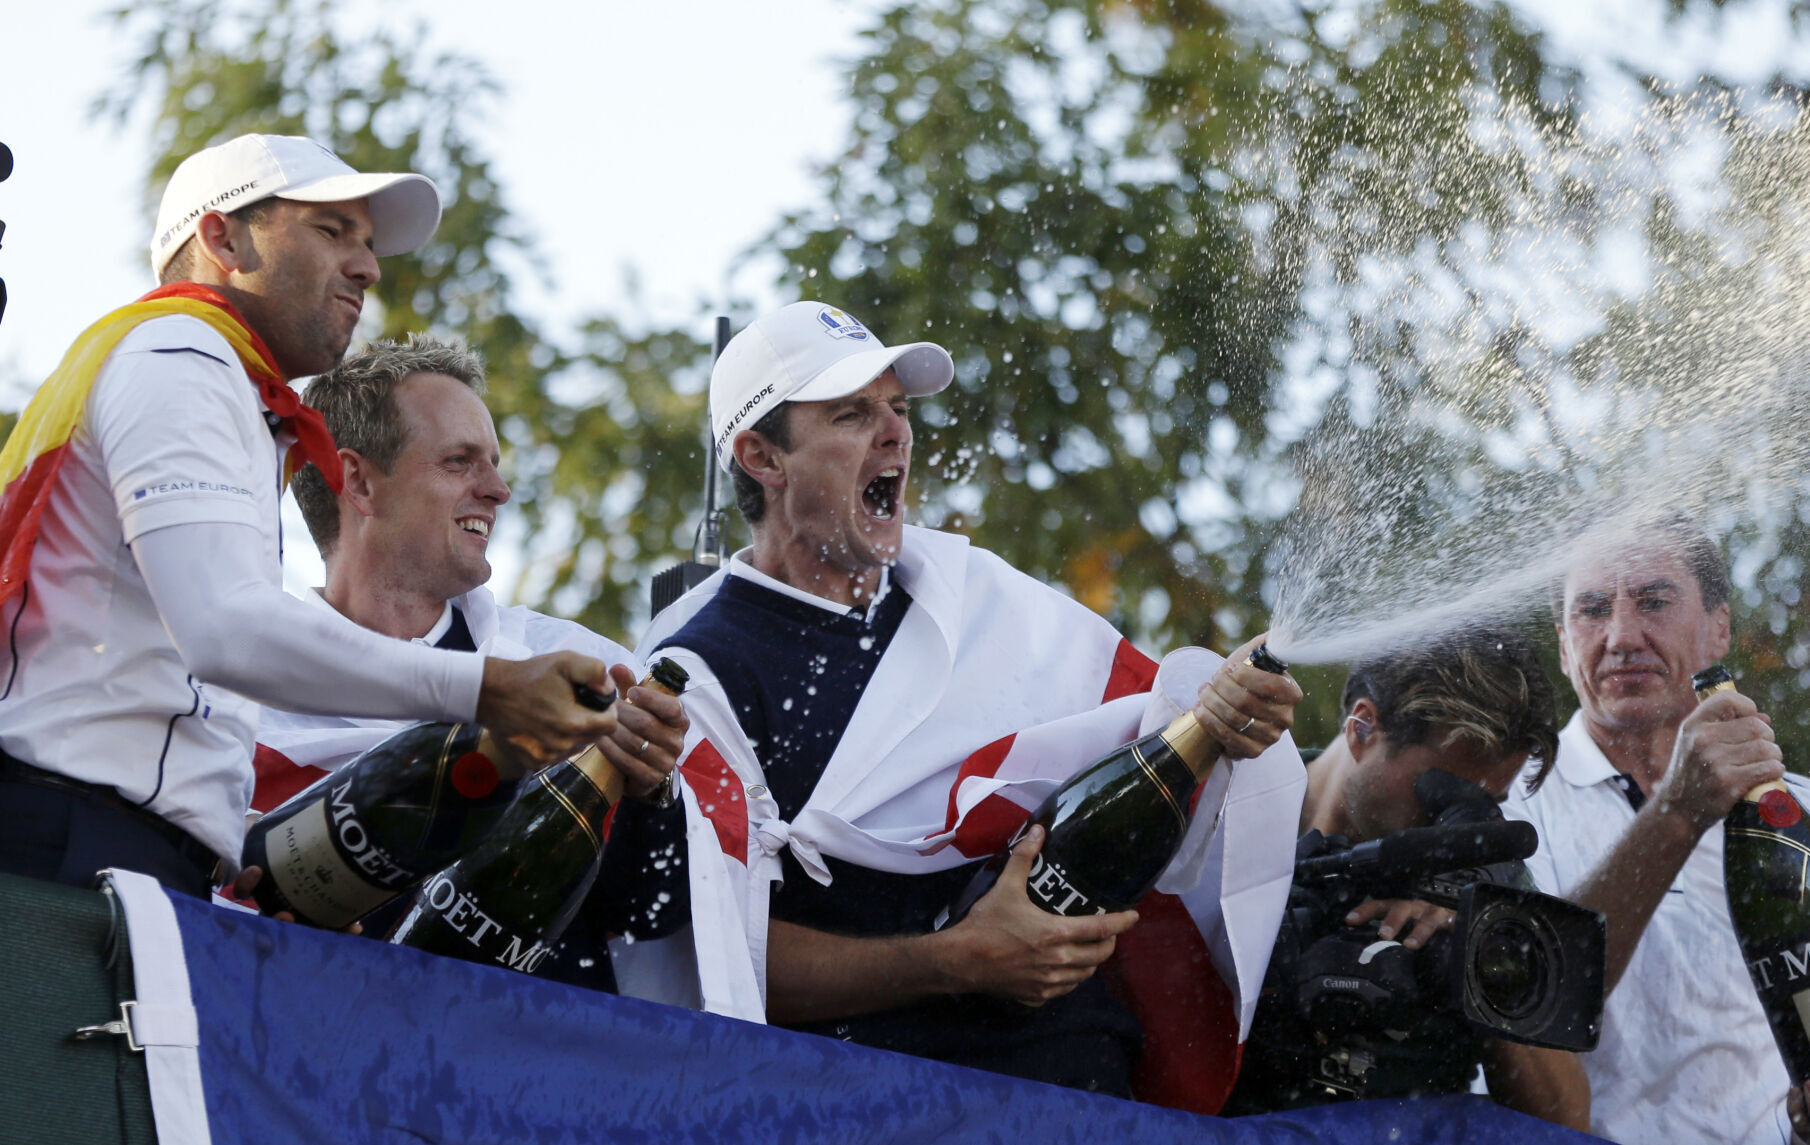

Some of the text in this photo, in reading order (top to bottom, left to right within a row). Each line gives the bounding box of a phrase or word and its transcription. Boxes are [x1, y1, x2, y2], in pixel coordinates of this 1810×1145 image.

[170, 179, 260, 237] TEAM EUROPE
[718, 383, 776, 446] TEAM EUROPE
[150, 482, 193, 494] TEAM
[331, 777, 415, 886] MOËT
[1322, 978, 1360, 990] Canon
